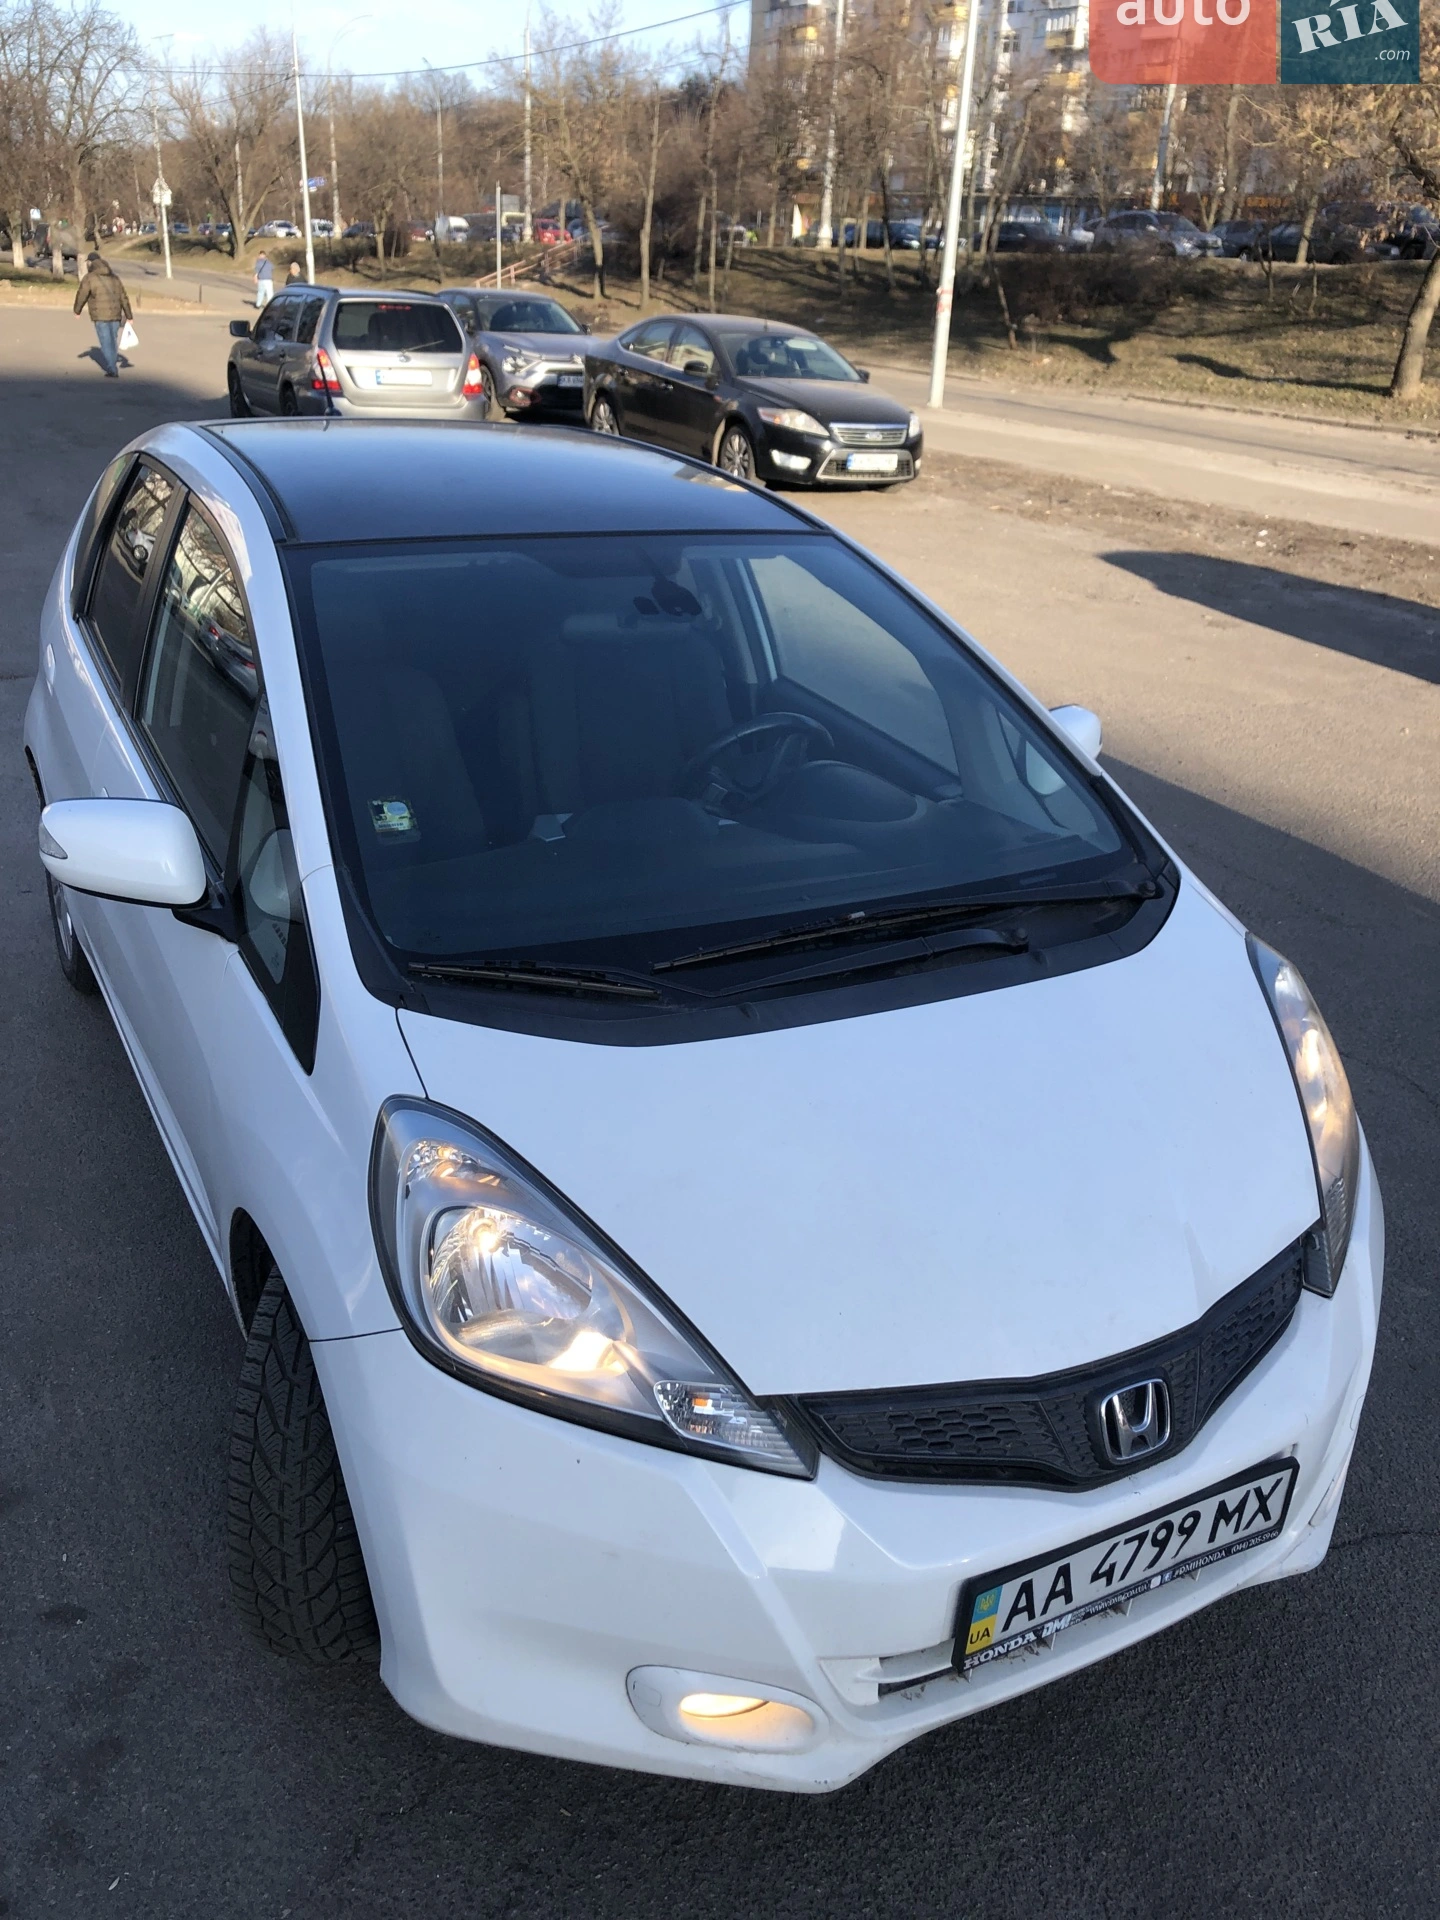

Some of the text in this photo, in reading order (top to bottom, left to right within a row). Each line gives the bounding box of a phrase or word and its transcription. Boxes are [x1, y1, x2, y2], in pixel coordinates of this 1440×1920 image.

[1001, 1477, 1283, 1633] AA 4799 MX
[963, 1629, 1038, 1670] HONDA
[969, 1627, 991, 1645] UA
